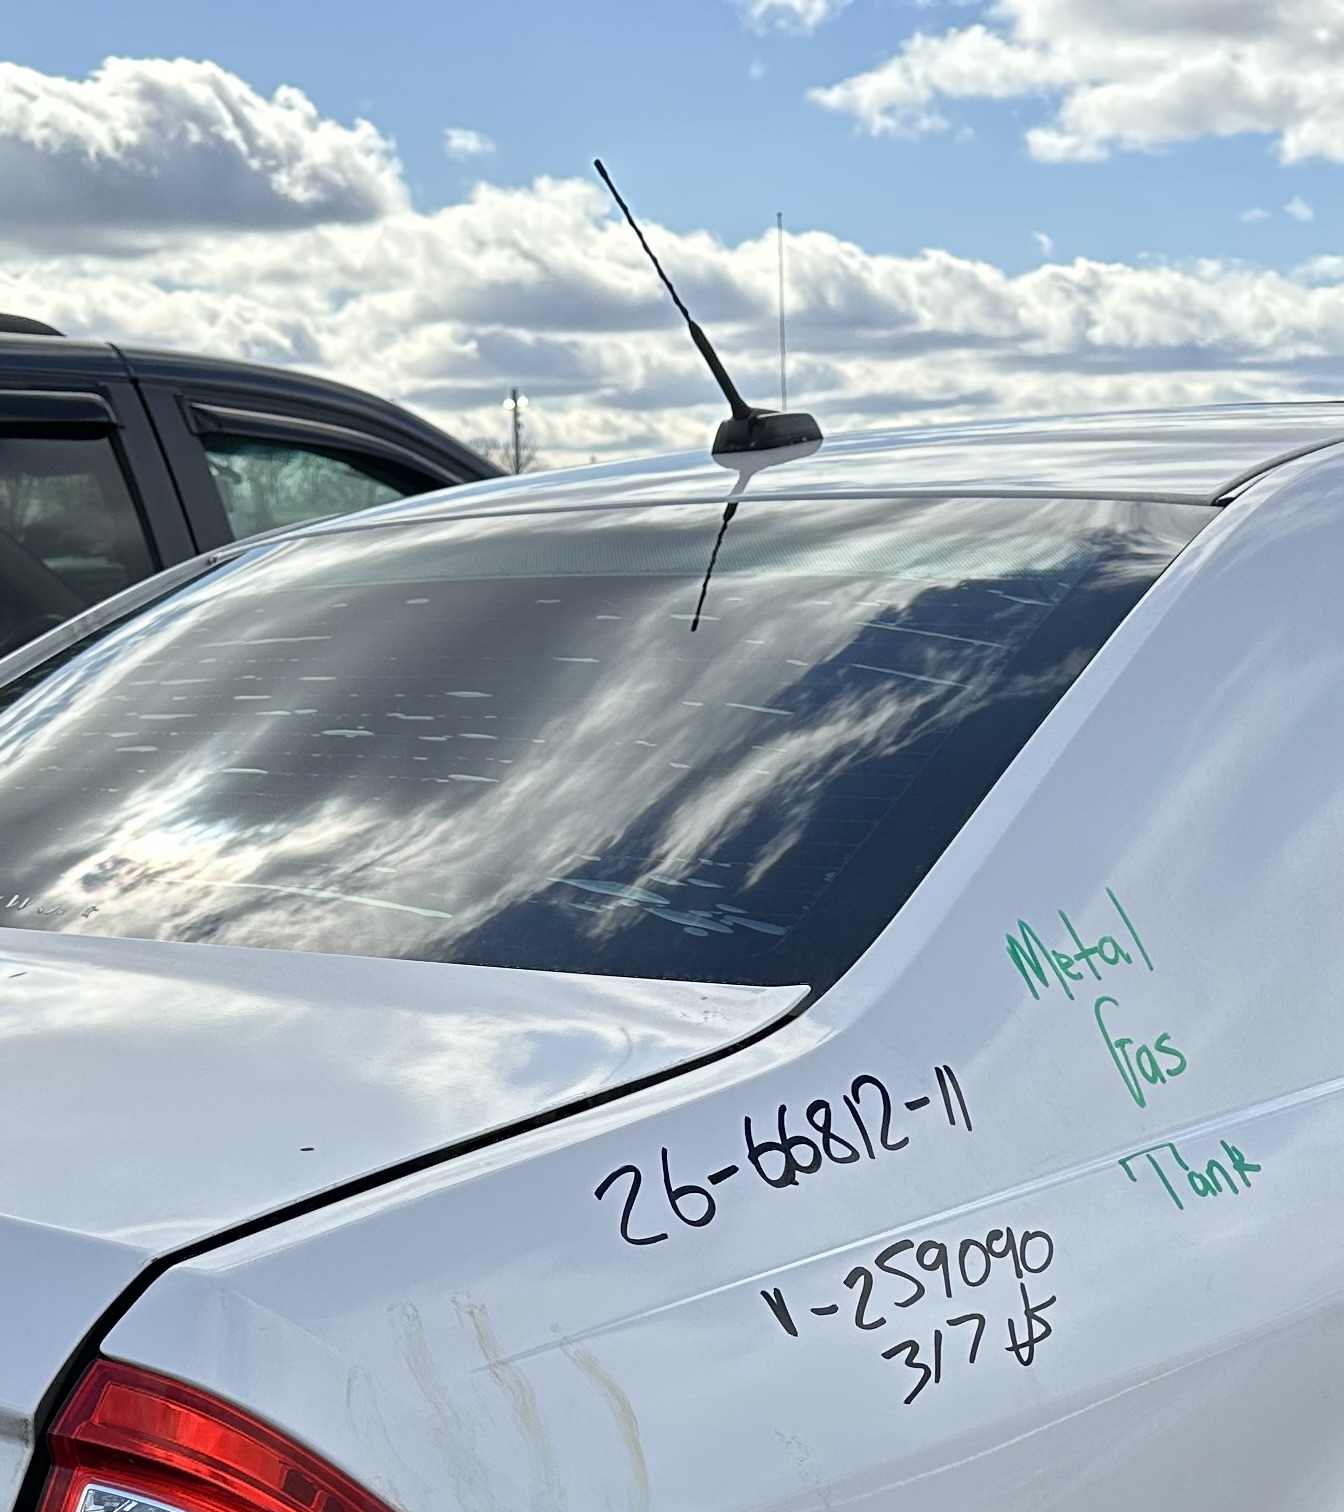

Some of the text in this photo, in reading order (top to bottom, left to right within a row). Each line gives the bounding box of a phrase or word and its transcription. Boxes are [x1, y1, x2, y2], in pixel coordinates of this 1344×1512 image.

[1006, 886, 1154, 1001] Metal
[1094, 996, 1188, 1109] Gas
[594, 1064, 973, 1246] 26-66812-11
[1117, 1139, 1262, 1210] Tank
[881, 1313, 986, 1405] 317
